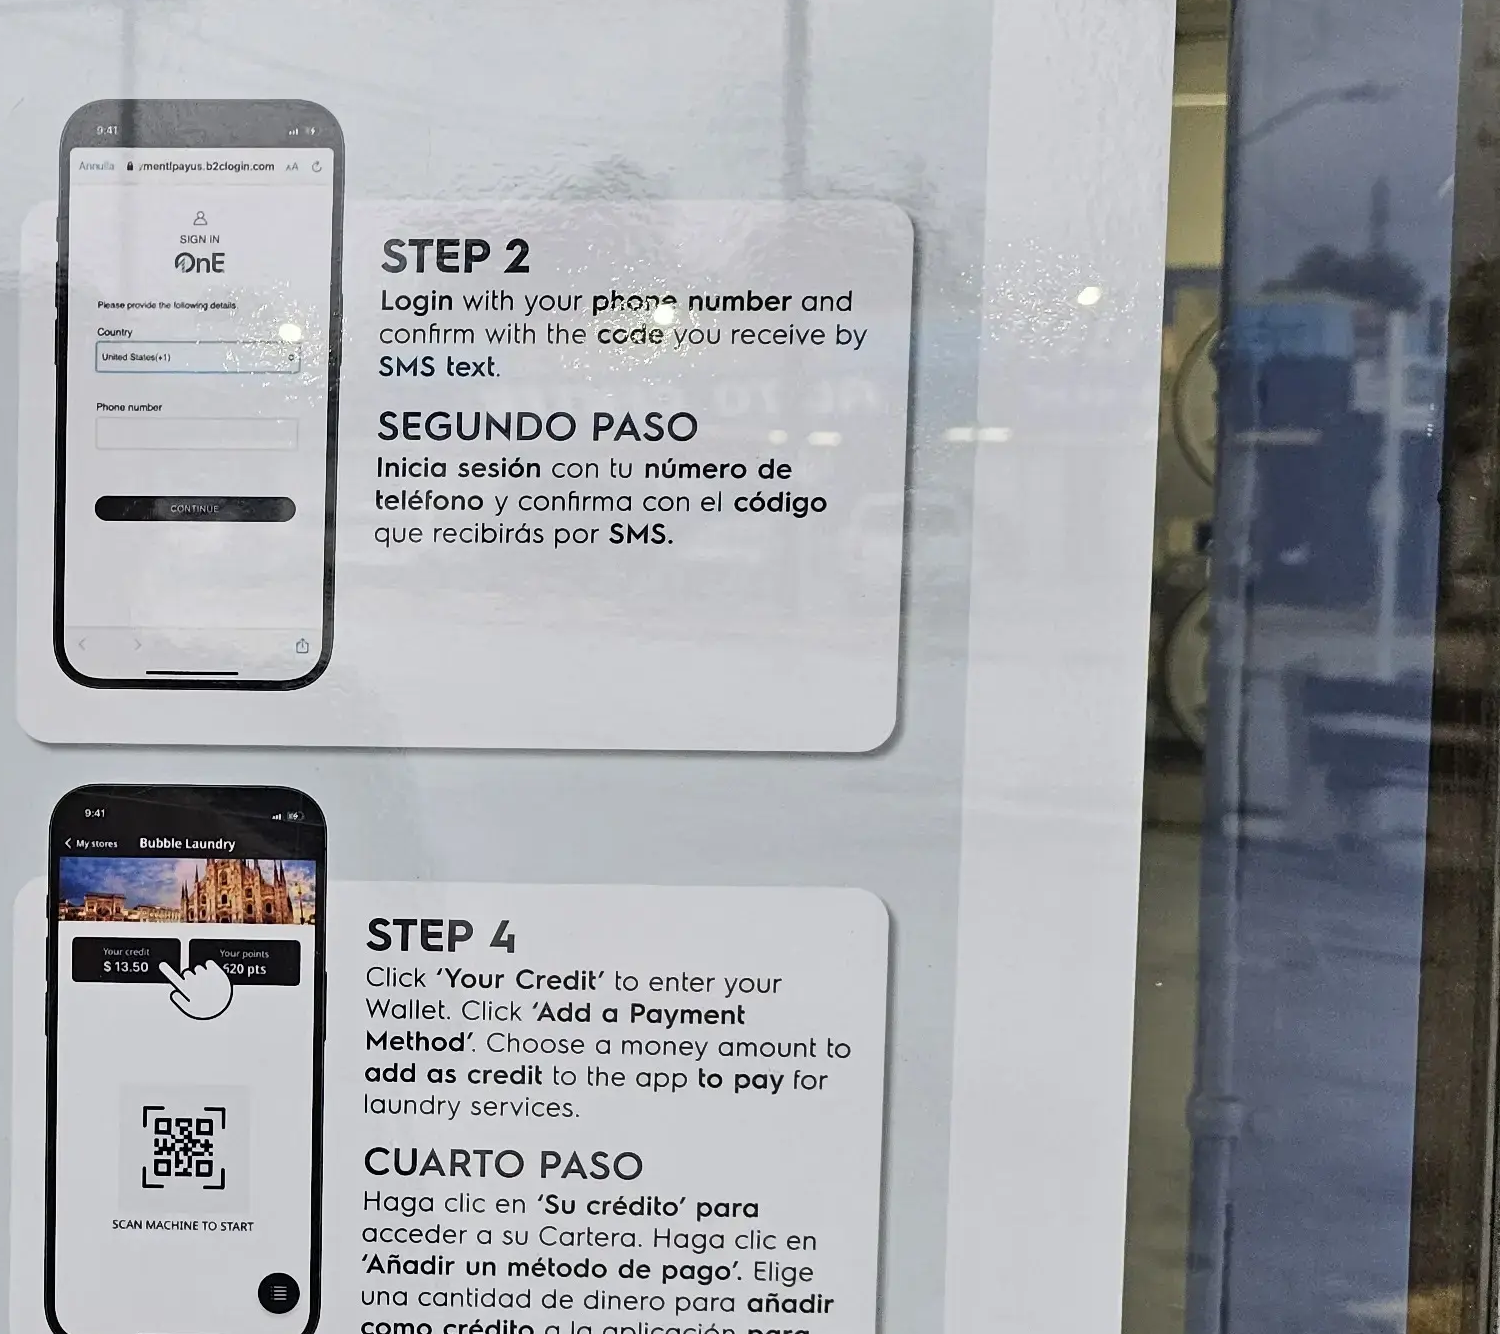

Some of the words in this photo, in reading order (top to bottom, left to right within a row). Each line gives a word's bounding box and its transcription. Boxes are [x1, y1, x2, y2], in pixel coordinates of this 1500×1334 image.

[97, 126, 118, 135] 9:41
[180, 235, 207, 244] SIGN
[210, 235, 220, 244] IN
[381, 239, 490, 273] STEP
[504, 238, 529, 273] 2
[98, 301, 125, 310] Please
[127, 301, 156, 311] provide
[159, 301, 171, 310] the
[173, 301, 208, 312] following
[97, 327, 132, 338] Country
[102, 353, 127, 362] United
[97, 403, 125, 412] Phone
[128, 403, 162, 412] number
[378, 411, 576, 441] SEGUNDO
[593, 412, 698, 441] PASO
[378, 457, 446, 477] Inicia
[458, 457, 540, 478] sesión
[552, 463, 598, 478] con
[610, 458, 632, 478] tu
[645, 458, 747, 479] número
[758, 458, 792, 479] de
[170, 504, 219, 513] CONTINUE
[85, 809, 105, 817] 9:41
[76, 839, 89, 848] My
[92, 839, 118, 848] stores
[140, 838, 182, 849] Bubble
[186, 838, 236, 852] Laundry
[366, 918, 473, 952] STEP
[490, 920, 515, 953] 4
[103, 948, 124, 956] Your
[126, 948, 150, 956] credit
[364, 1147, 524, 1178] CUARTO
[541, 1151, 643, 1180] PASO
[112, 1220, 142, 1230] SCAN
[146, 1220, 198, 1230] MACHINE
[202, 1221, 217, 1231] TO
[220, 1222, 254, 1231] START
[361, 1291, 407, 1306] una
[418, 1288, 530, 1308] cantidad
[542, 1289, 573, 1309] de
[584, 1290, 665, 1311] dinero
[676, 1296, 735, 1316] para
[747, 1293, 835, 1314] añadir
